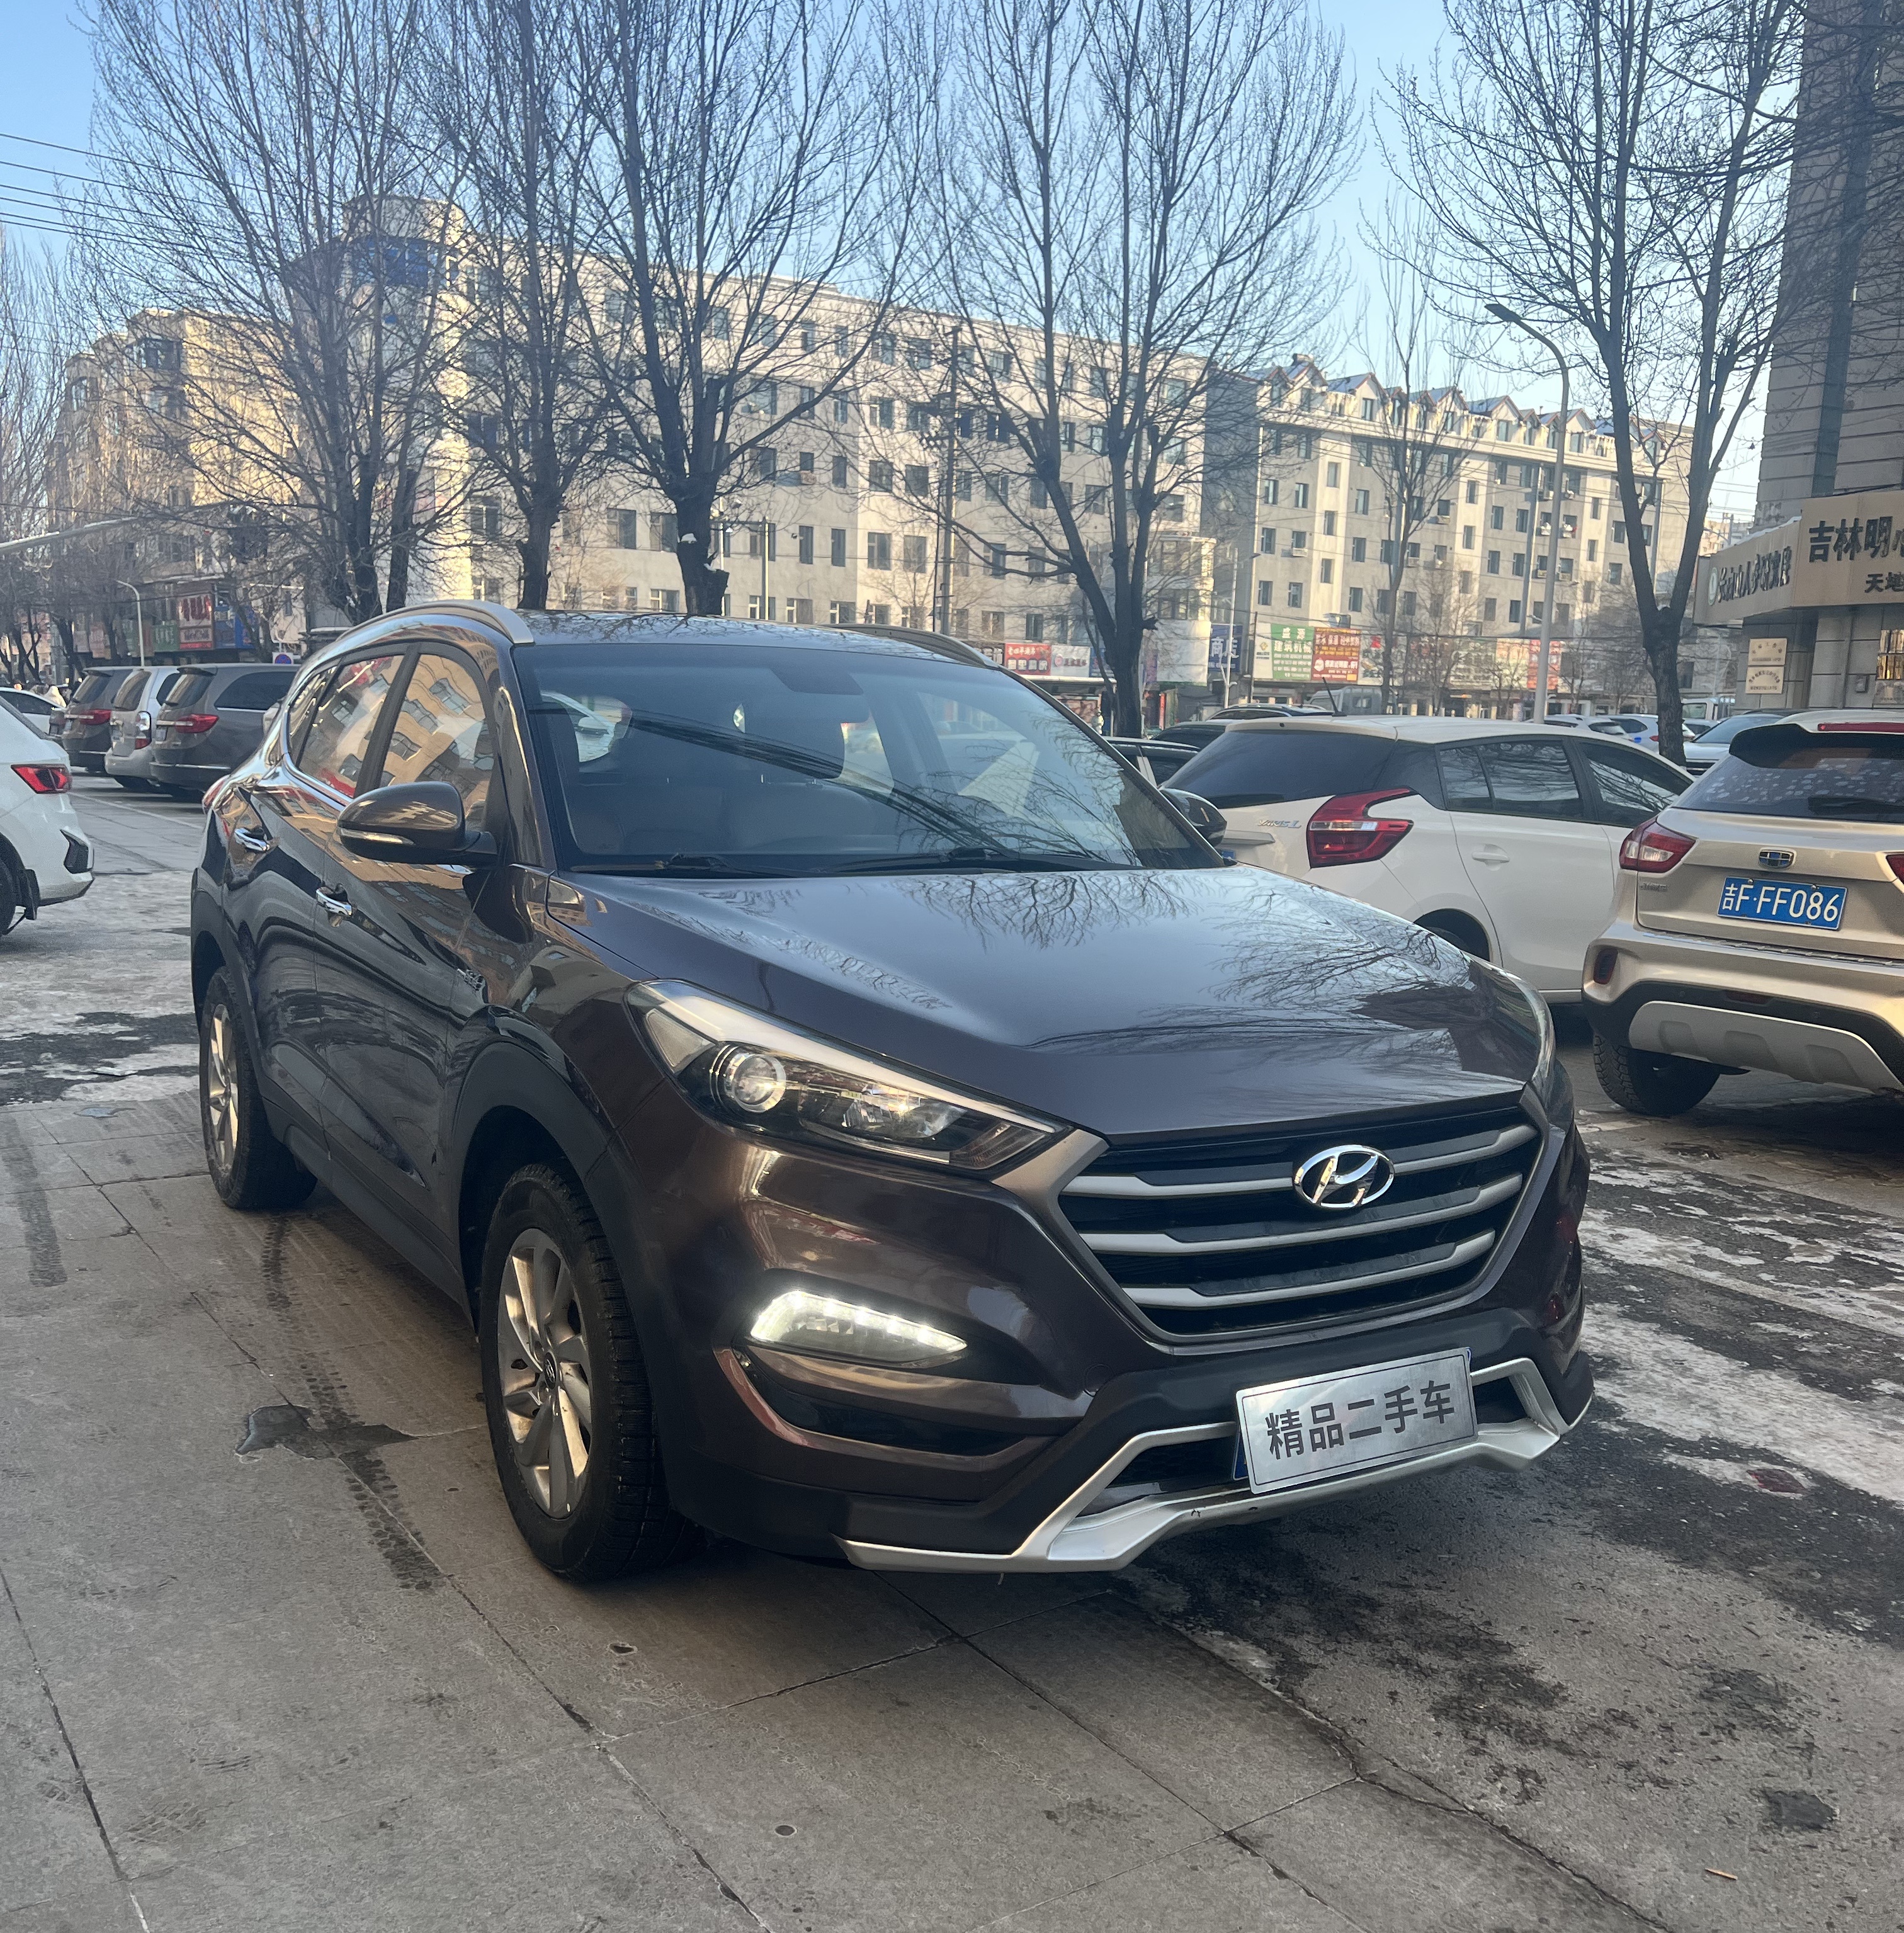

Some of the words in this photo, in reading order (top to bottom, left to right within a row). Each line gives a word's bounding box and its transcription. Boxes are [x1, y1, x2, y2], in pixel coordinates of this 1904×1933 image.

[1266, 1380, 1455, 1460] 精品二手车
